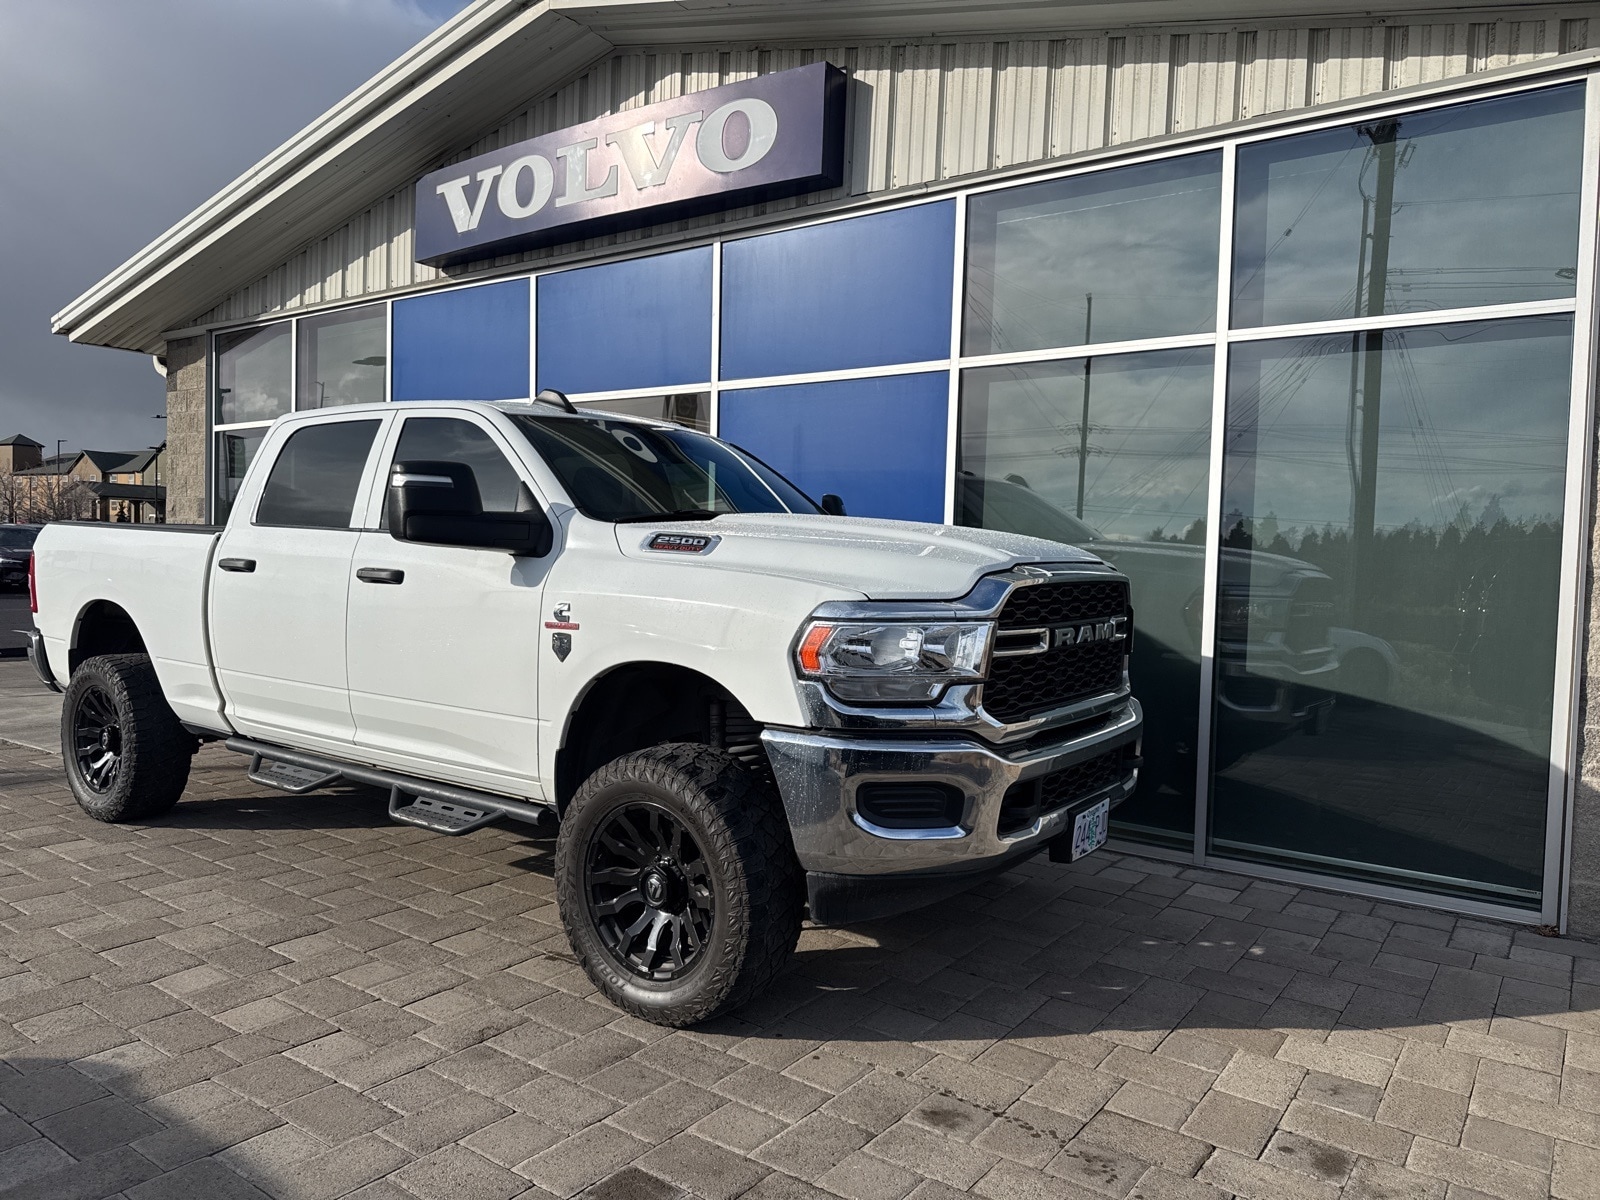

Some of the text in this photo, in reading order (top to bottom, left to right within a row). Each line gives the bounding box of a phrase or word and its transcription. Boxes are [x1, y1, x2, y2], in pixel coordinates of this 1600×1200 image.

[436, 97, 778, 234] VOLVO
[656, 535, 706, 546] 2500
[1054, 622, 1112, 648] RAM
